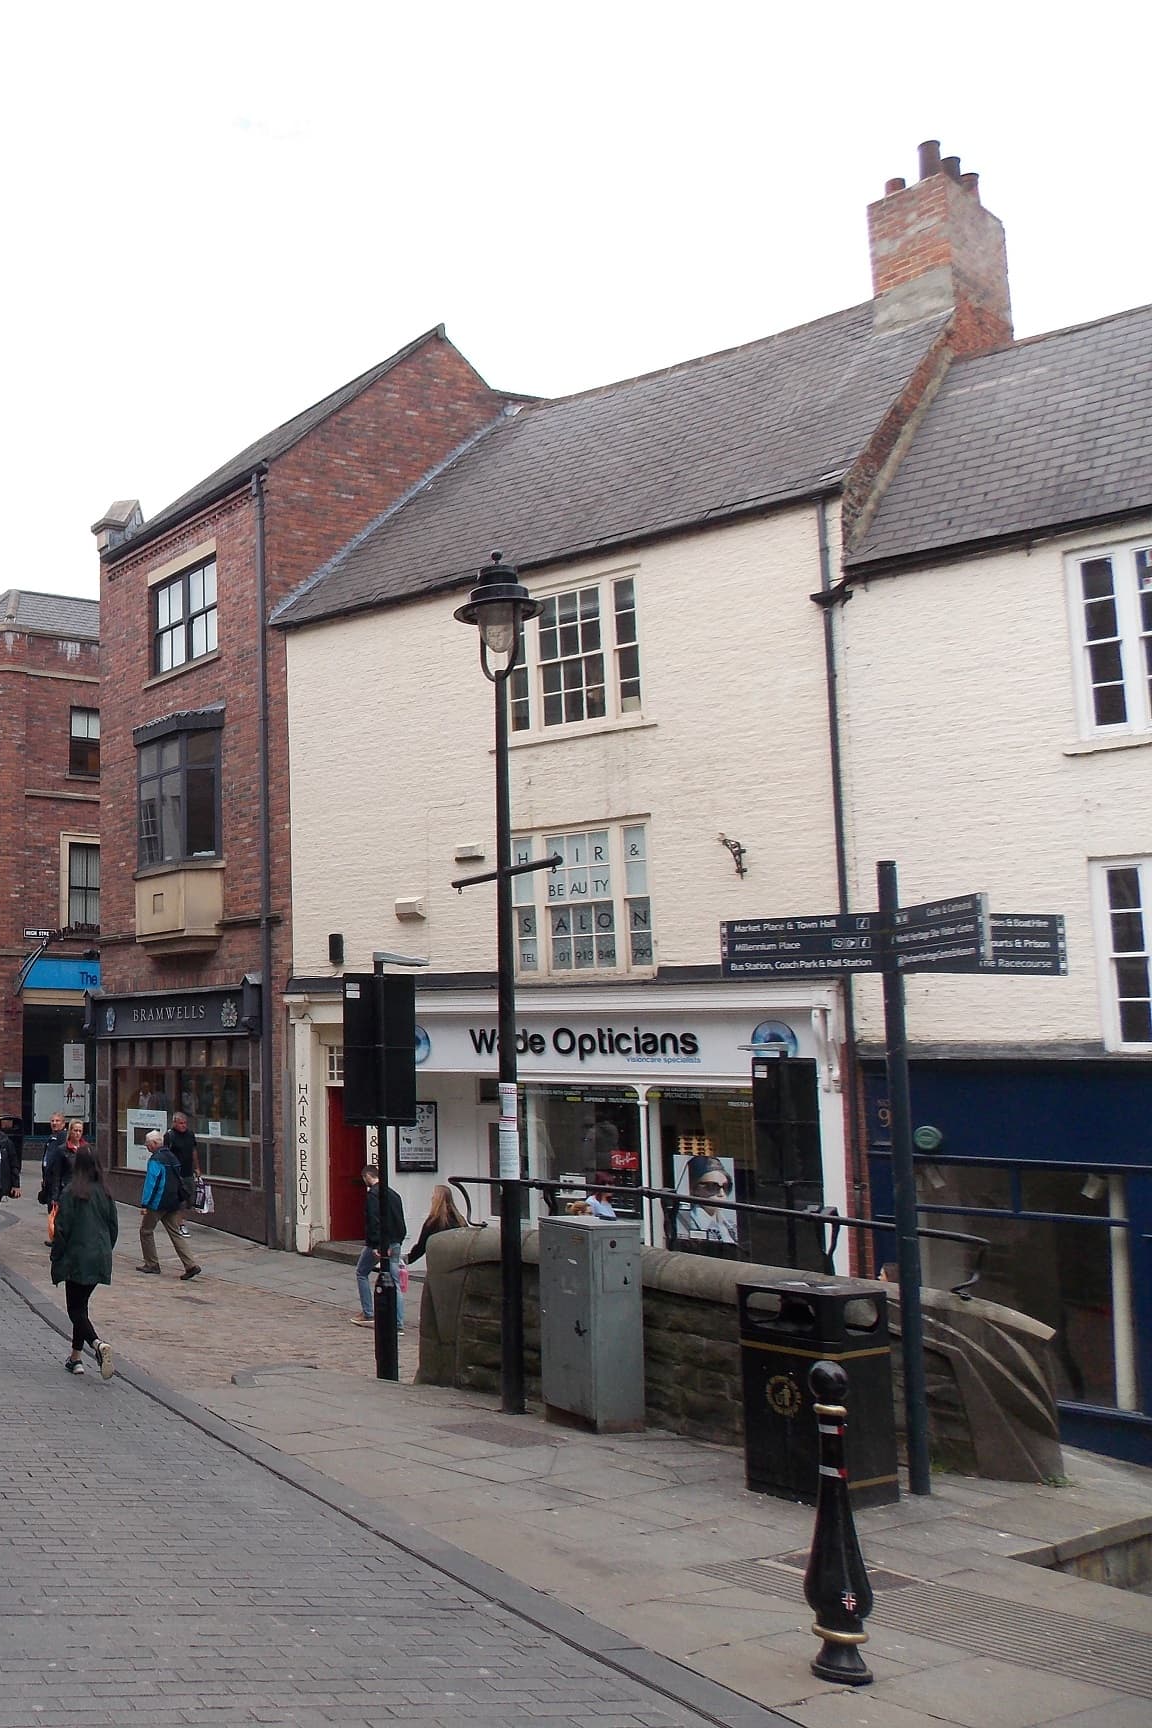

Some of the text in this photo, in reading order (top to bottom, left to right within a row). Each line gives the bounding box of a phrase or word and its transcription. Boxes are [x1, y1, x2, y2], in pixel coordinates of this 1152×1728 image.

[548, 879, 609, 897] BEAUTY
[734, 919, 837, 933] Market Place & Town Hall
[735, 941, 801, 951] Millennium Place
[992, 939, 1051, 948] ourts & Prison
[521, 953, 536, 963] TEL
[730, 962, 744, 971] Bus
[775, 960, 799, 970] Coach
[799, 959, 818, 969] Park
[819, 959, 826, 967] &
[827, 959, 842, 967] Rail
[843, 957, 872, 967] Station
[998, 958, 1053, 968] Racecourse
[79, 971, 98, 985] The
[132, 1005, 206, 1023] BRAMWELLS
[469, 1026, 699, 1061] Wde Opticians
[298, 1083, 309, 1128] HAIR
[298, 1132, 309, 1144] &
[298, 1149, 310, 1216] BEAUTY
